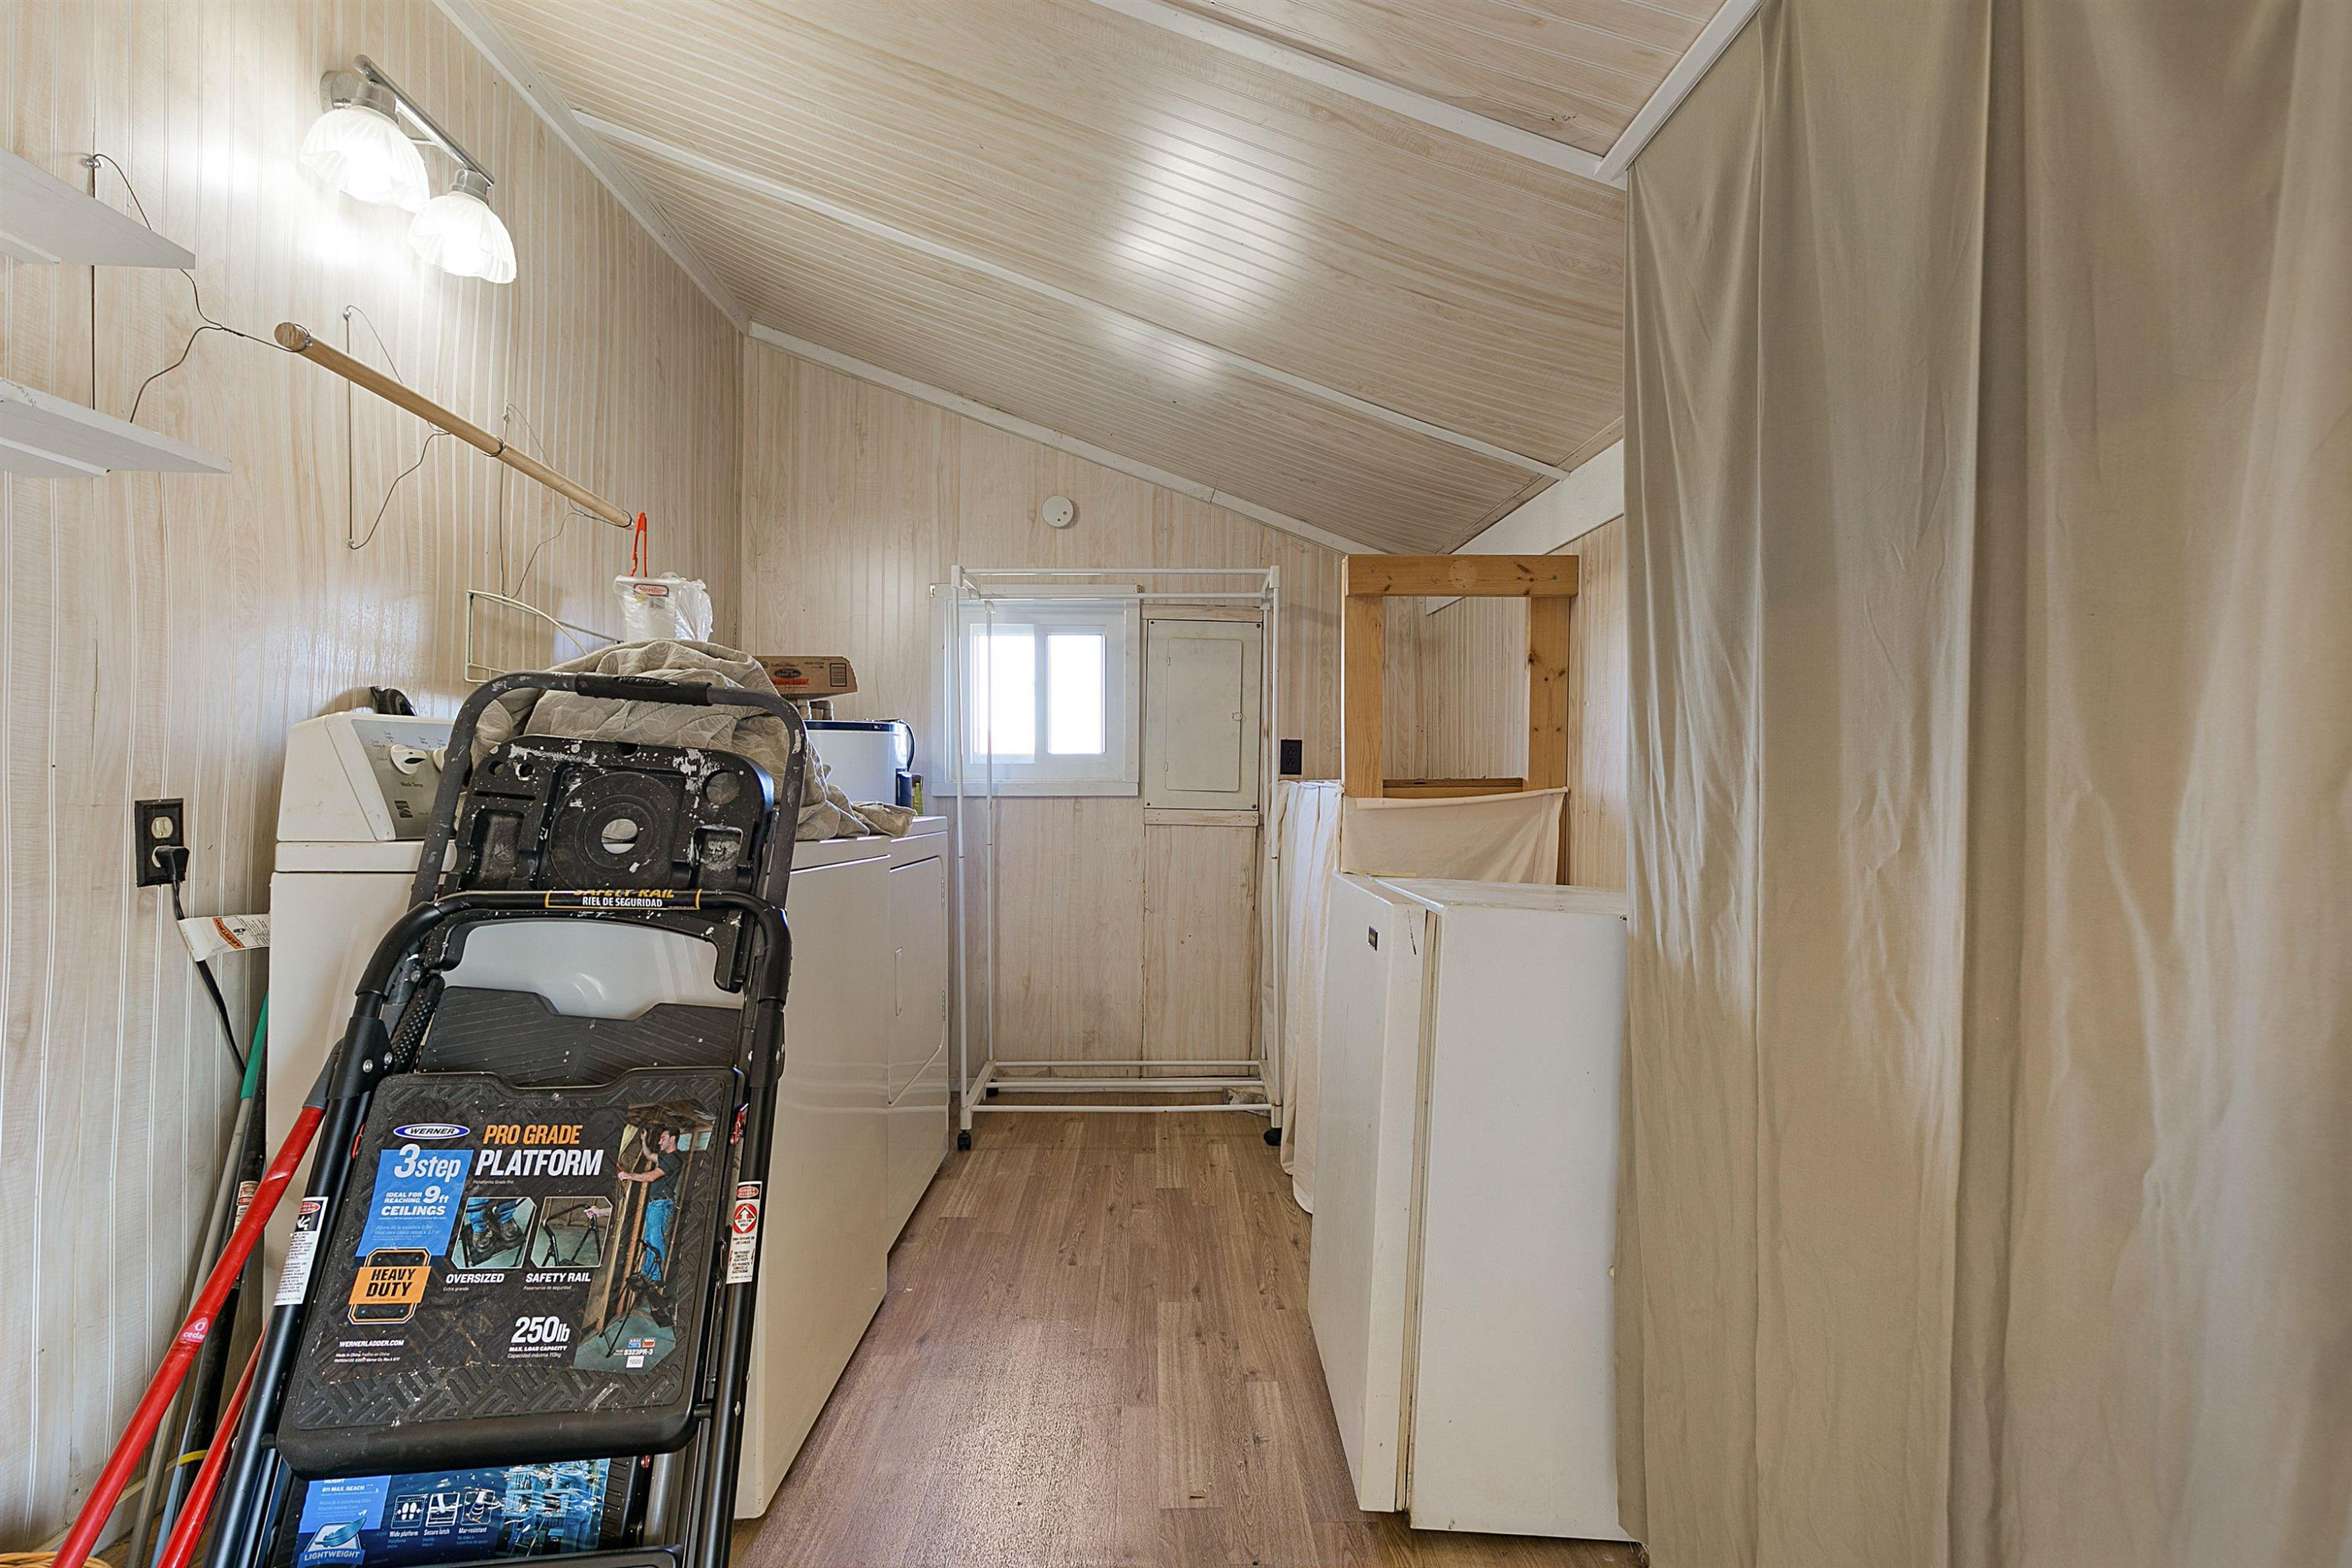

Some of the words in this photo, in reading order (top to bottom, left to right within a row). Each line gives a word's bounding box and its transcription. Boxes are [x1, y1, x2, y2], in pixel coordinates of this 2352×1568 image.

[583, 897, 601, 906] RIEL
[602, 897, 613, 906] DE
[615, 897, 662, 907] SEGURIDAD
[483, 1124, 521, 1145] PRO
[523, 1124, 583, 1145] GRADE
[474, 1149, 604, 1176] PLATFORM
[381, 1206, 446, 1216] CEILINGS
[371, 1269, 416, 1280] HEAVY
[445, 1273, 505, 1283] OVERSIZED
[525, 1272, 567, 1283] SAFETY
[567, 1272, 591, 1282] RAIL
[366, 1282, 412, 1297] DUTY
[183, 1331, 205, 1340] cedar
[303, 1550, 361, 1561] LIGHTWEIGHT
